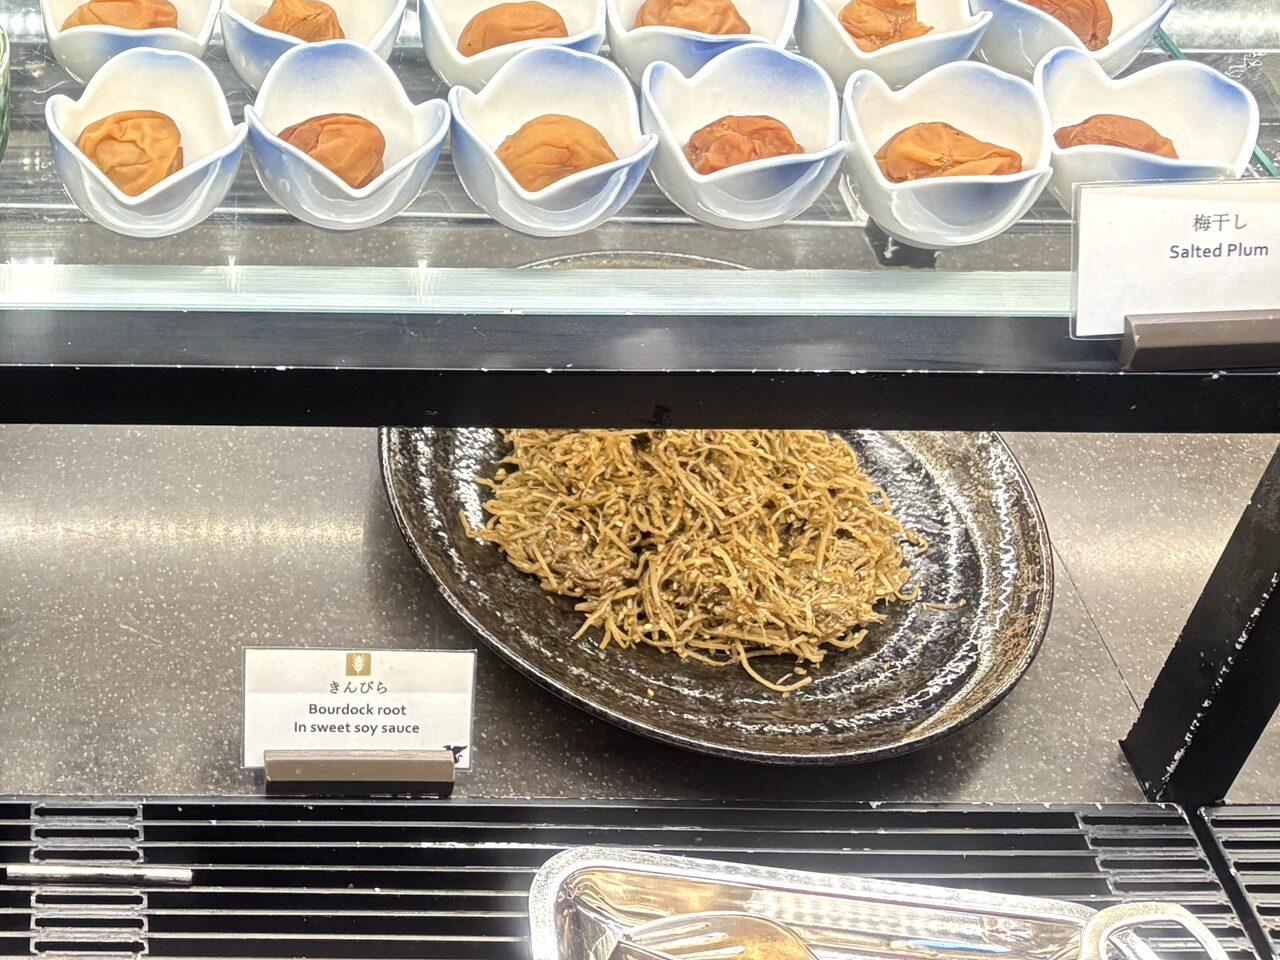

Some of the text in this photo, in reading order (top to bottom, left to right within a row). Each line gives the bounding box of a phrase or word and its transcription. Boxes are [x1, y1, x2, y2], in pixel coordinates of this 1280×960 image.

[1192, 213, 1248, 232] 梅干し
[1169, 243, 1269, 259] Salted Plum
[328, 681, 388, 694] きんぴら
[308, 703, 406, 716] Bourdock root
[294, 721, 420, 736] In sweet soy sauce
